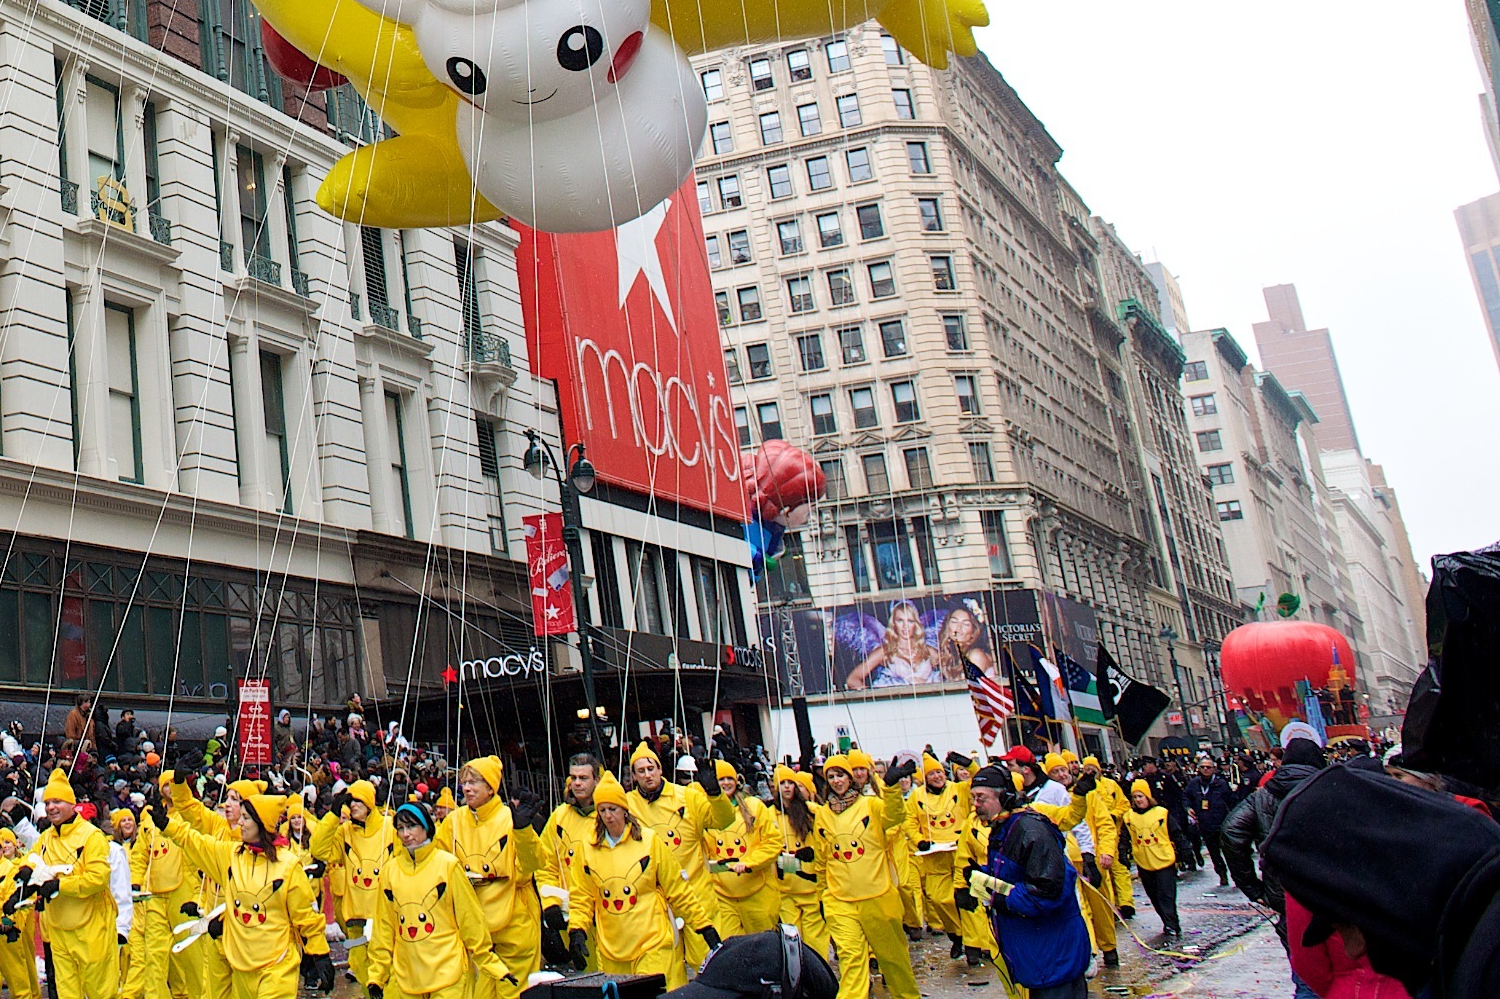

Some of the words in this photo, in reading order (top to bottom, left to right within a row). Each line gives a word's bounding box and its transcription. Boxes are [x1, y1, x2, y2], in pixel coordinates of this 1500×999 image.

[574, 335, 739, 504] macy's
[1002, 633, 1035, 643] SECRET
[461, 645, 545, 682] macy's
